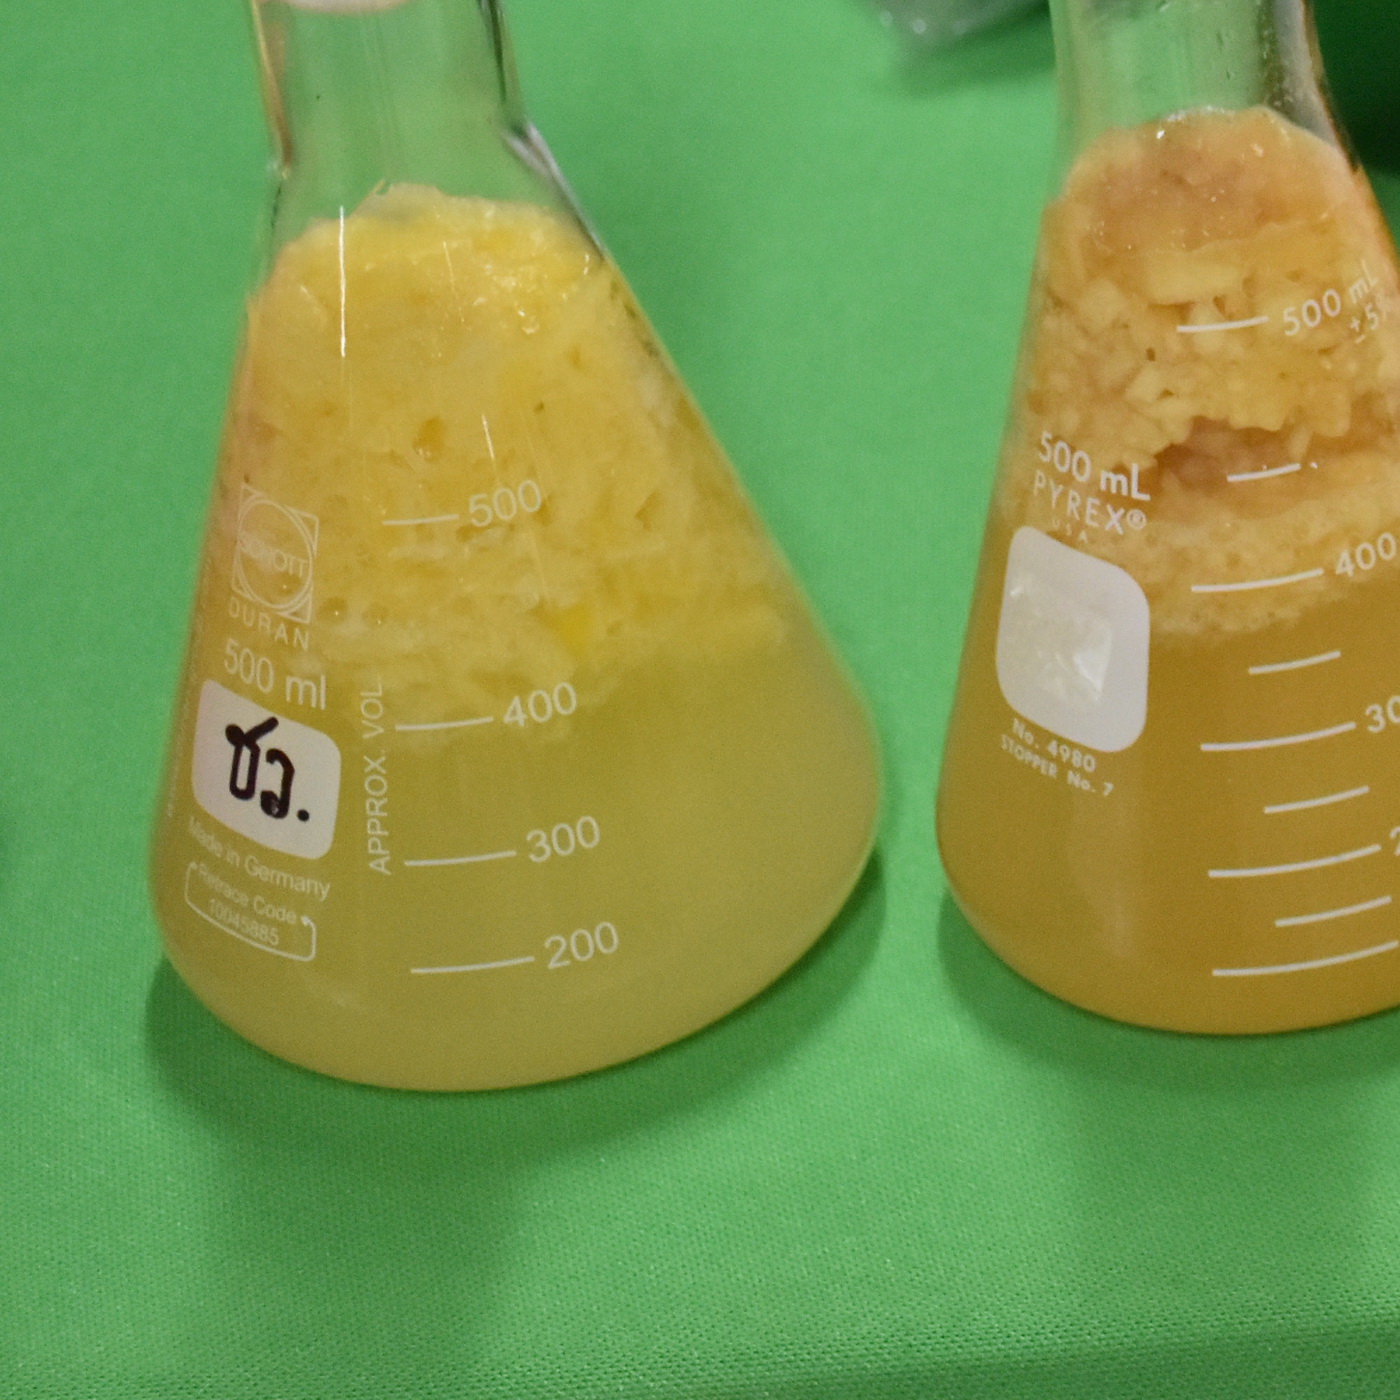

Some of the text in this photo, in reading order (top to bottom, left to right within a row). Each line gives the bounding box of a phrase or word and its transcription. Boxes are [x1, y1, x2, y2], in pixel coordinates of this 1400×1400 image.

[1283, 288, 1342, 337] 500
[1038, 430, 1152, 501] 500 mL
[469, 479, 543, 529] 500
[1333, 532, 1398, 580] 400
[228, 596, 310, 651] DURAN
[224, 637, 327, 711] 500 ml
[502, 681, 578, 727] 400
[1000, 733, 1114, 797] STOPPER No. 7
[1012, 717, 1097, 773] No. 4980
[364, 748, 391, 886] APPROX.
[525, 814, 602, 863] 300
[226, 845, 241, 868] in
[244, 854, 331, 903] Germany
[252, 894, 297, 925] Code
[544, 921, 620, 970] 200
